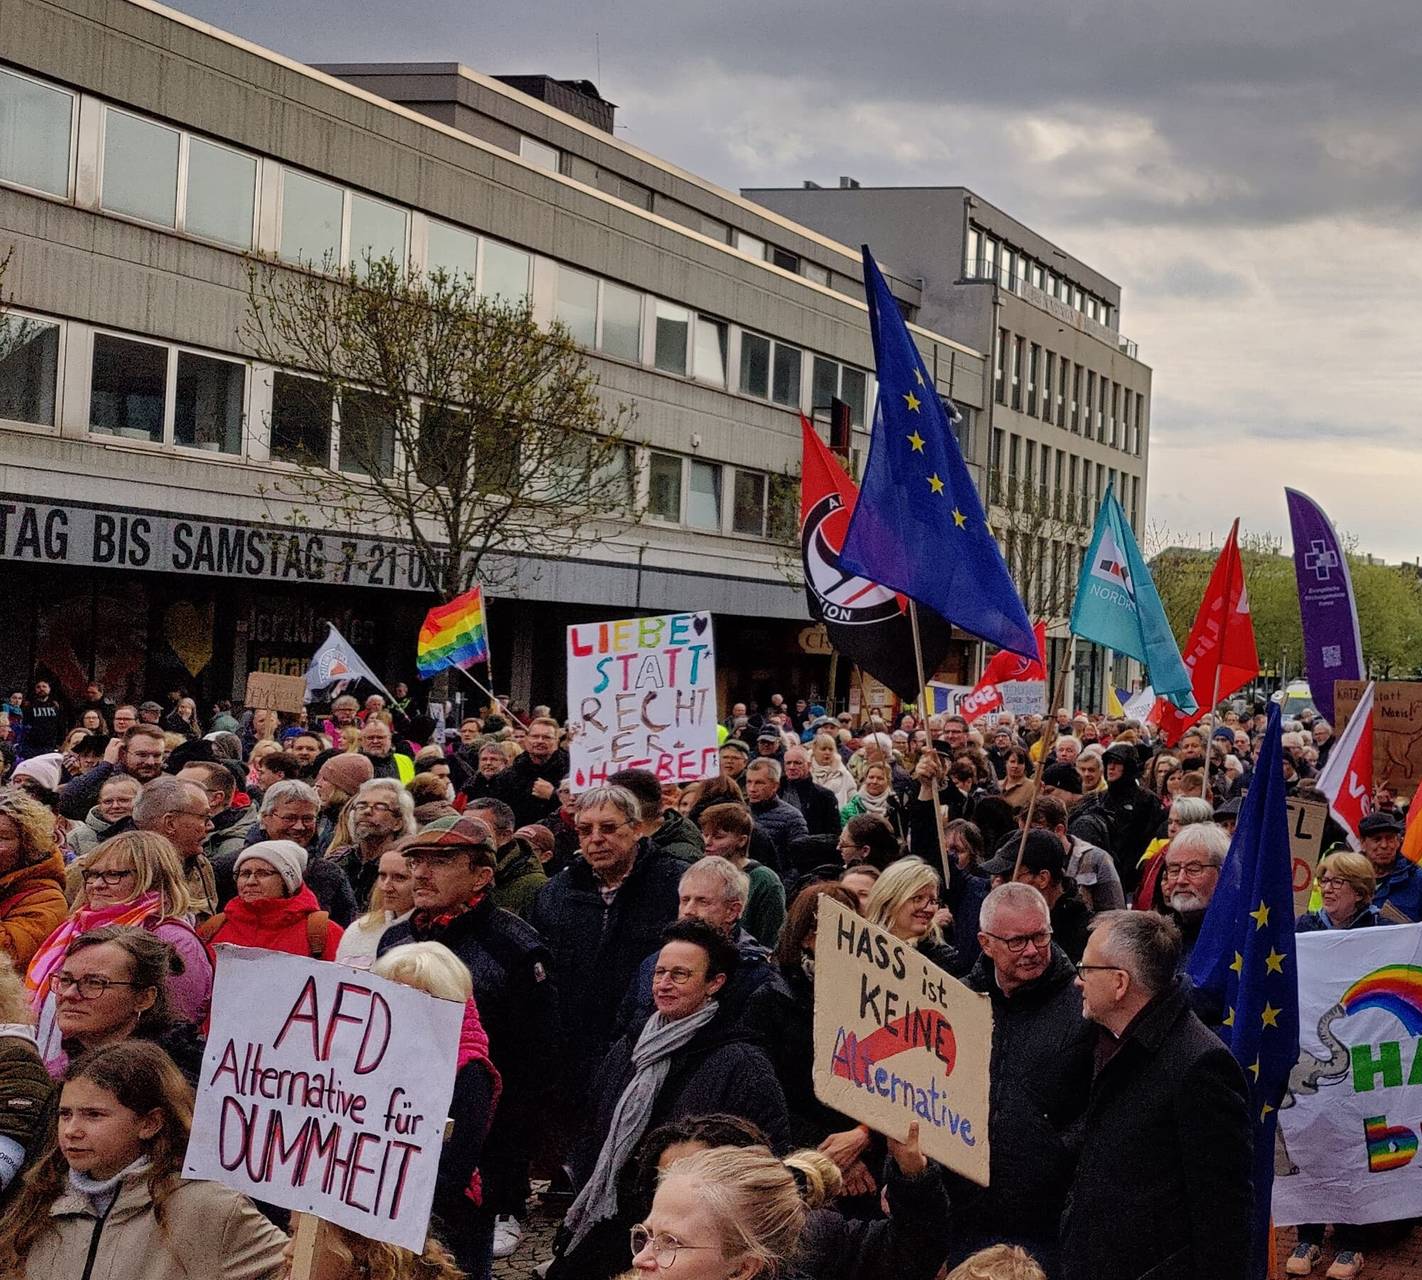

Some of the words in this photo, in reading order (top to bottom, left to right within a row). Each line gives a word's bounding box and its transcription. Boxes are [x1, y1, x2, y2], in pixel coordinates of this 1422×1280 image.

[93, 513, 151, 566] BIS
[172, 521, 325, 580] SAMSTAG
[571, 615, 691, 657] LIEBE
[593, 644, 709, 694] STATT
[581, 688, 709, 733] RECHT
[837, 913, 906, 980] HASS
[921, 966, 948, 1009] ist
[273, 975, 391, 1075] AFD
[860, 973, 950, 1064] KEINE
[210, 1037, 366, 1125] Alternative
[384, 1087, 424, 1135] für
[830, 1026, 976, 1147] Alternative
[218, 1095, 422, 1220] DUMMHEIT
